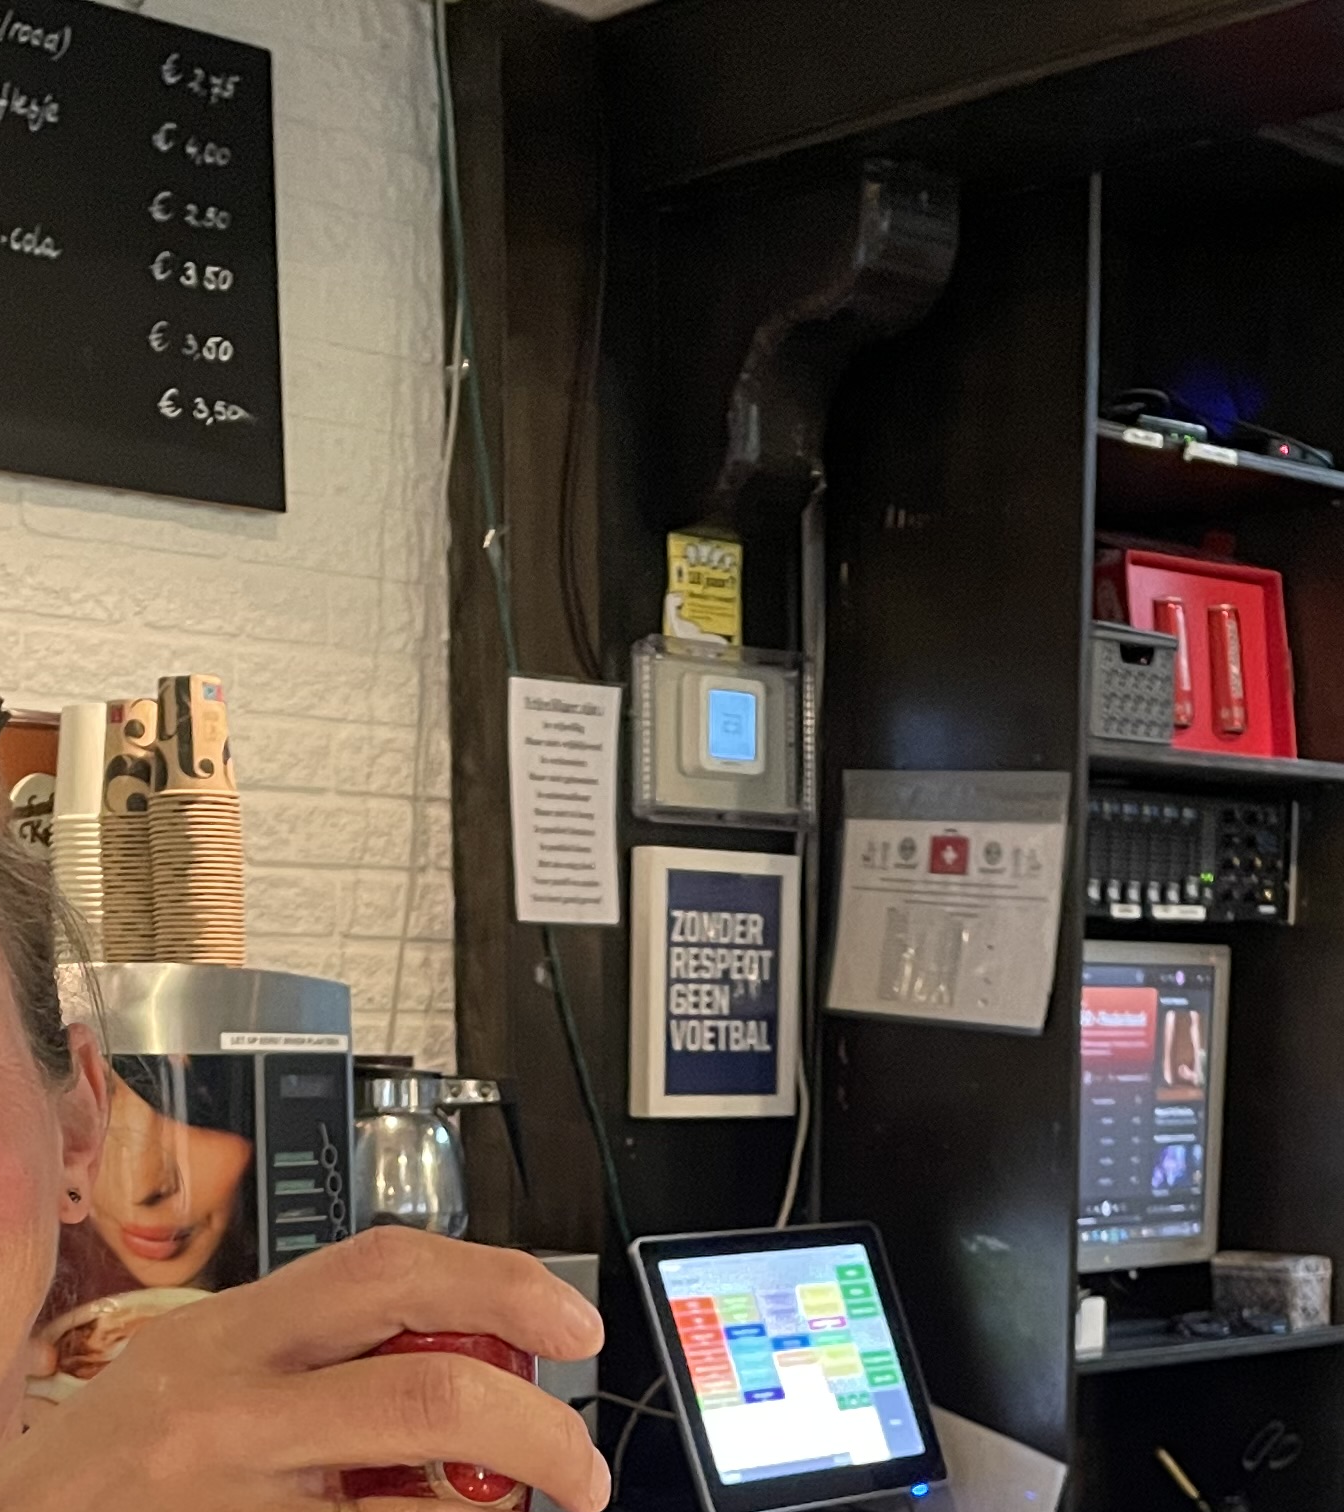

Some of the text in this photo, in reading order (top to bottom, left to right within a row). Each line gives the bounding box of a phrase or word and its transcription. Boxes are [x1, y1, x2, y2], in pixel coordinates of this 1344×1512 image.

[182, 333, 234, 362] 3,50
[192, 397, 246, 426] 3,50
[670, 909, 765, 946] ZONDER
[670, 946, 773, 981] RESPECT
[670, 983, 731, 1016] GEEN
[670, 1019, 772, 1052] VOETBAL
